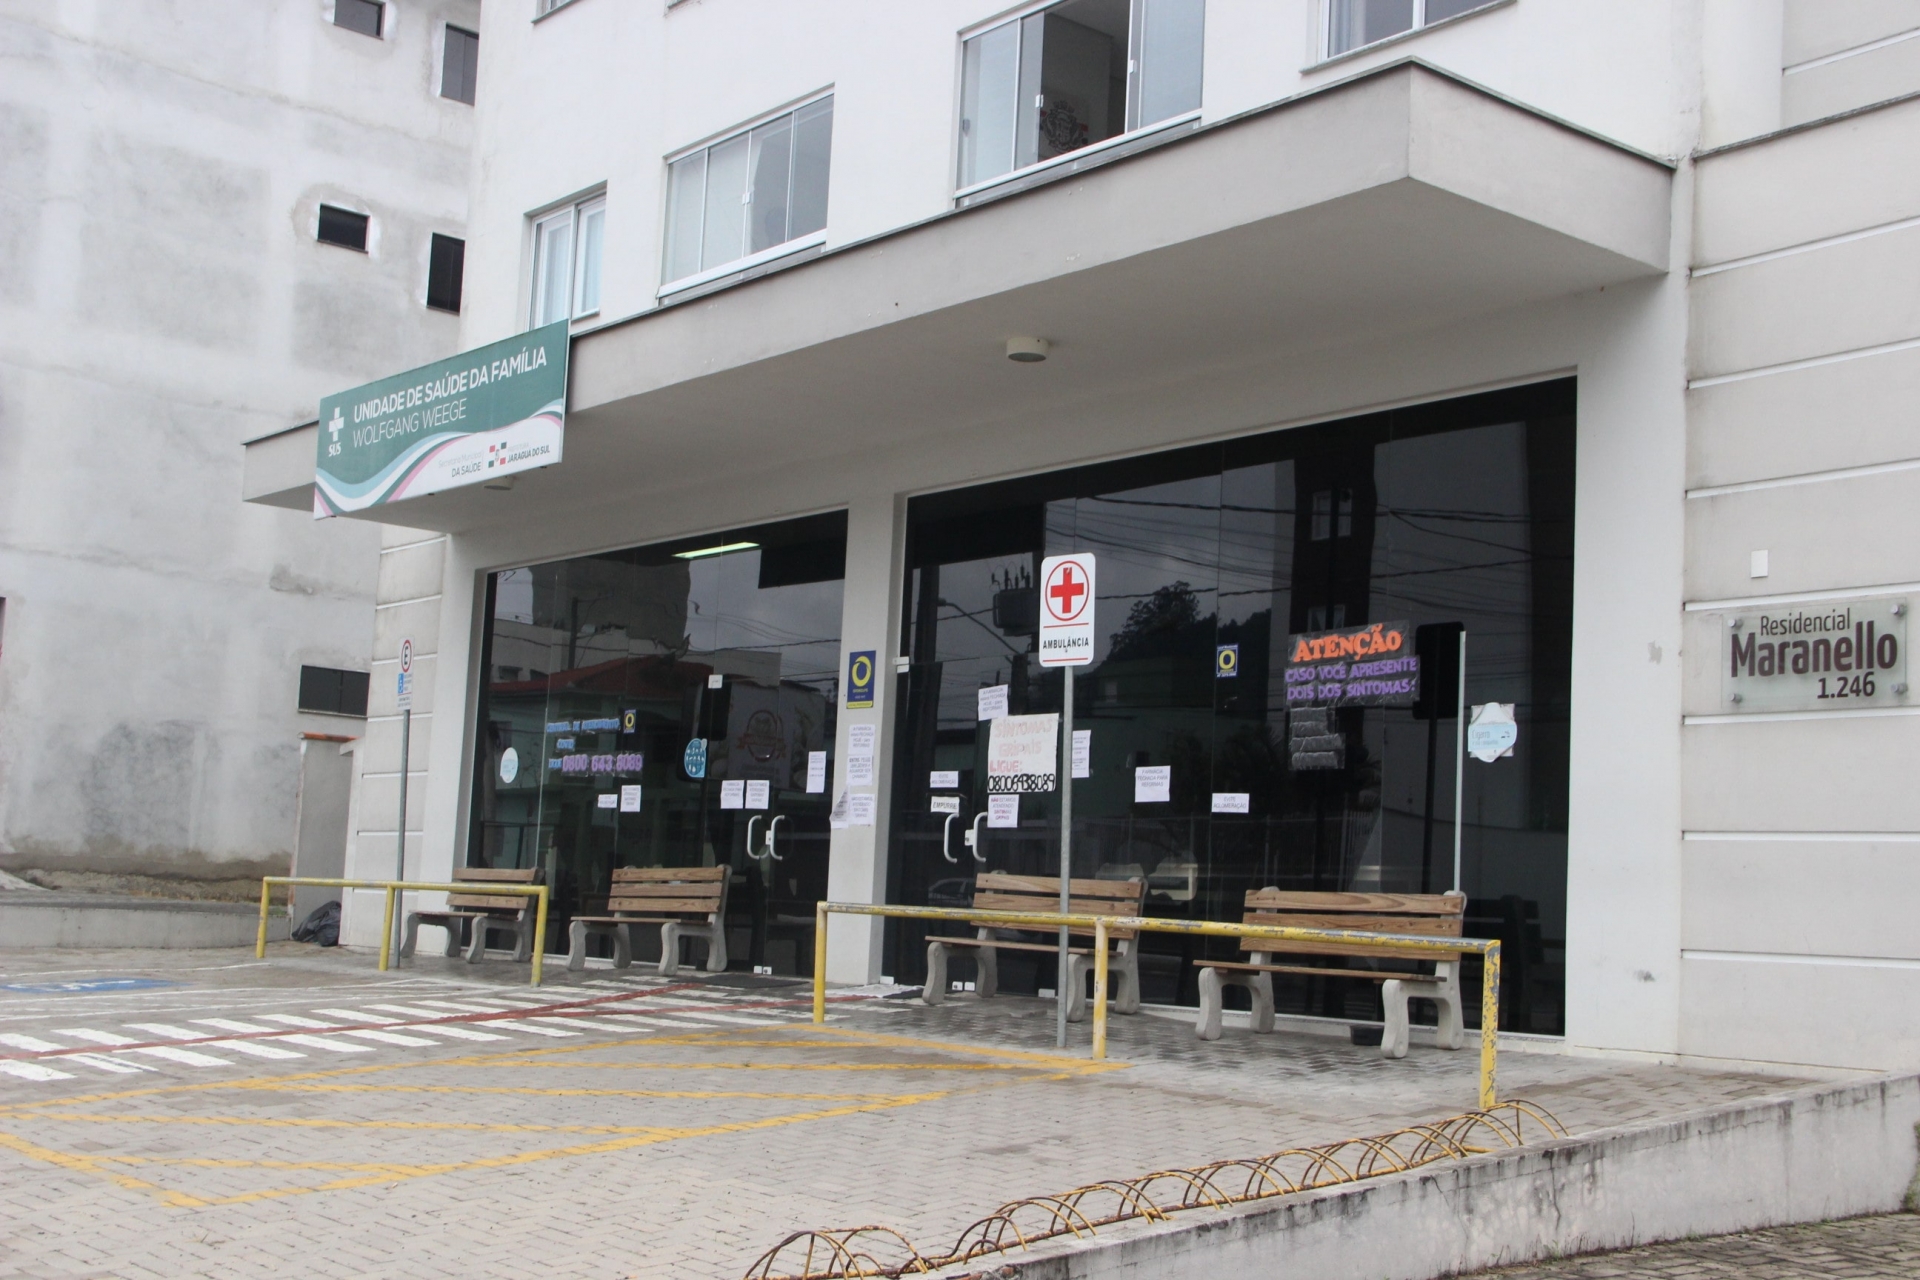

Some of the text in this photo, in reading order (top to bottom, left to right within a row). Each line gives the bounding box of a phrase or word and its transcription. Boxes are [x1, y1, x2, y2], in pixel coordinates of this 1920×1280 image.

[354, 346, 547, 423] UNIDADE DE SAÚDE DA FAMÍLIA
[353, 398, 467, 448] WOLFGANG WEEGE
[328, 442, 341, 457] SUS
[532, 448, 540, 456] DO
[540, 445, 550, 454] SUL
[452, 461, 481, 478] DA SAÚDE
[1760, 607, 1851, 636] Residencial
[1043, 636, 1089, 649] AMBULÂNCIA
[1293, 622, 1402, 662] ATENÇÃO
[1731, 620, 1898, 678] Maranello
[1285, 657, 1417, 683] CASO VOCÊ APRESENTE
[1287, 686, 1315, 700] DOIS
[1318, 683, 1343, 699] DOS
[1817, 671, 1875, 699] 1.246
[562, 754, 588, 772] 0800
[591, 754, 613, 772] 643
[616, 753, 643, 772] 8089
[989, 760, 1022, 773] LIGUE:
[932, 801, 957, 810] EMPURRE
